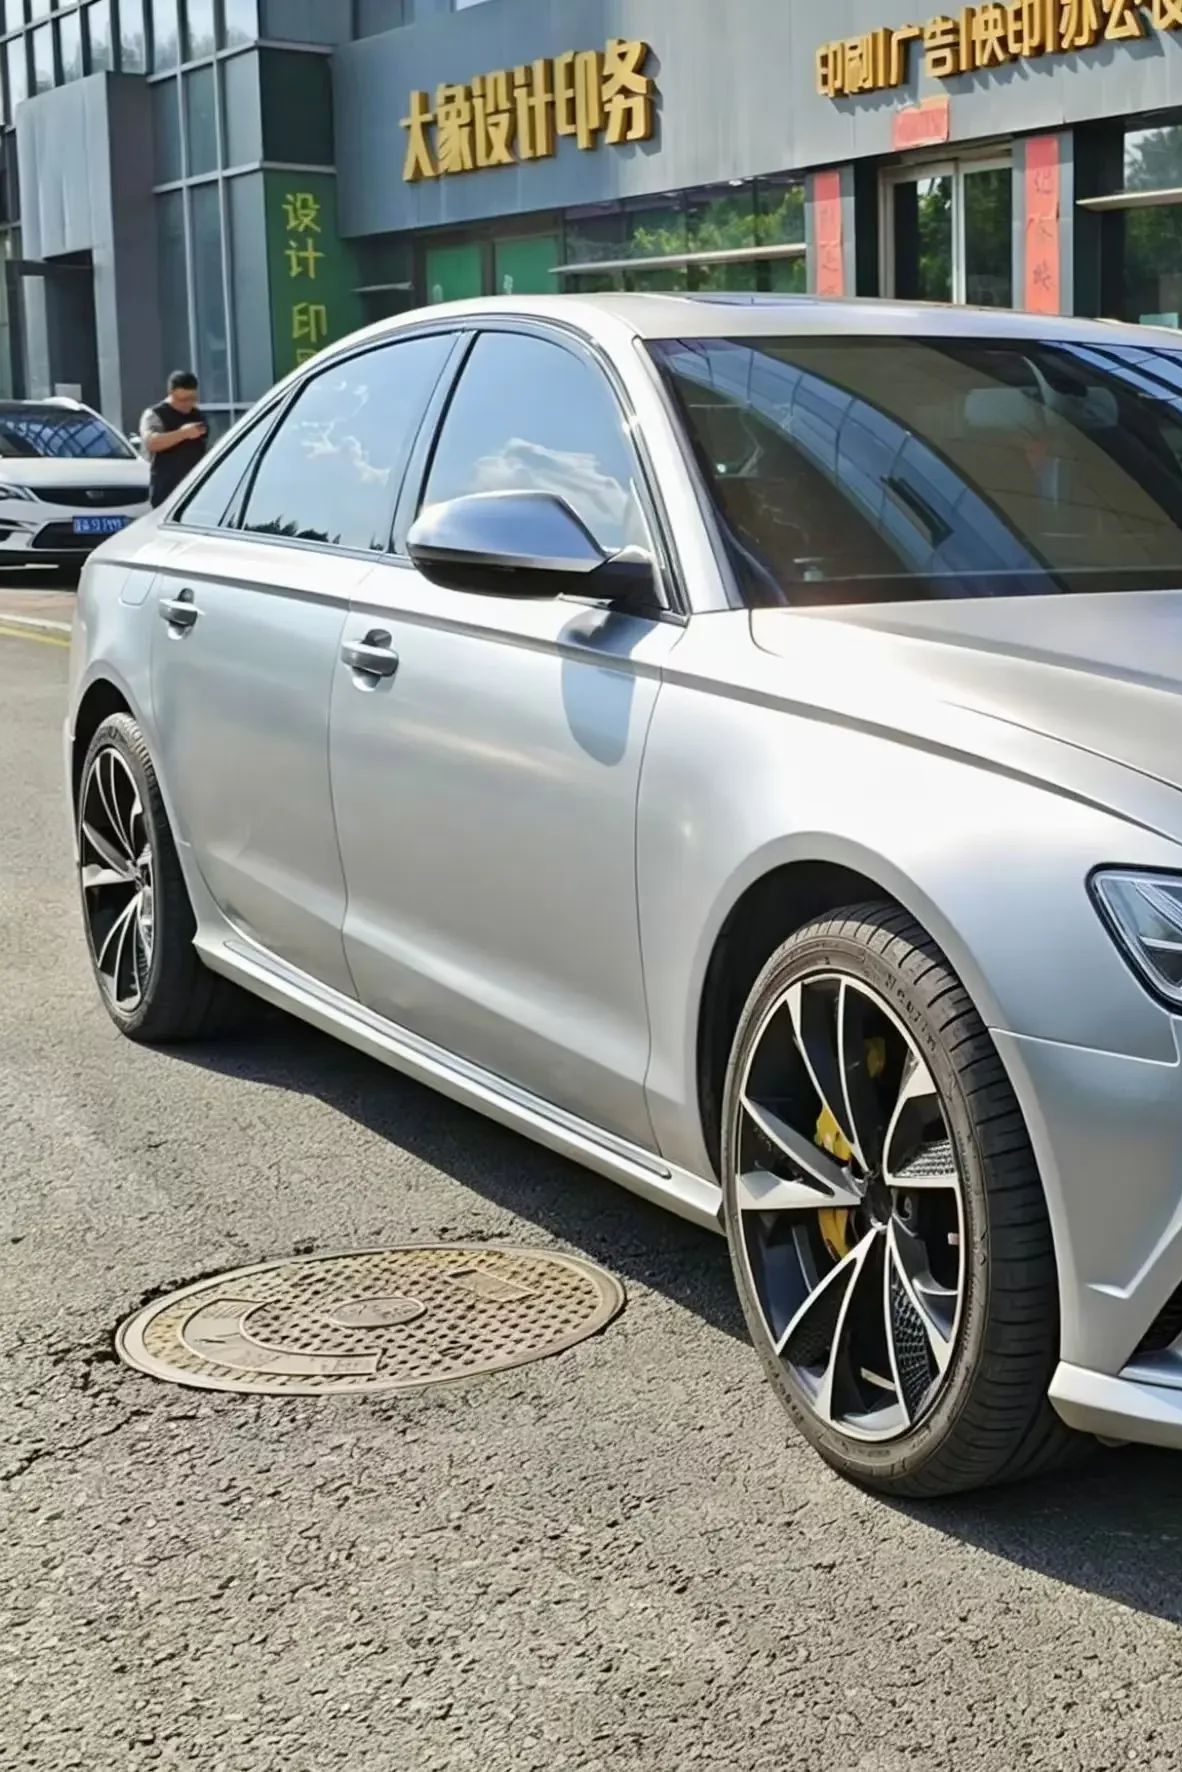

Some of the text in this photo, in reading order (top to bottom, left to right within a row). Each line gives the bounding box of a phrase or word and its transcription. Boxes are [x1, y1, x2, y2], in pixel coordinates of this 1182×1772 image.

[400, 38, 654, 182] 大象设计印务
